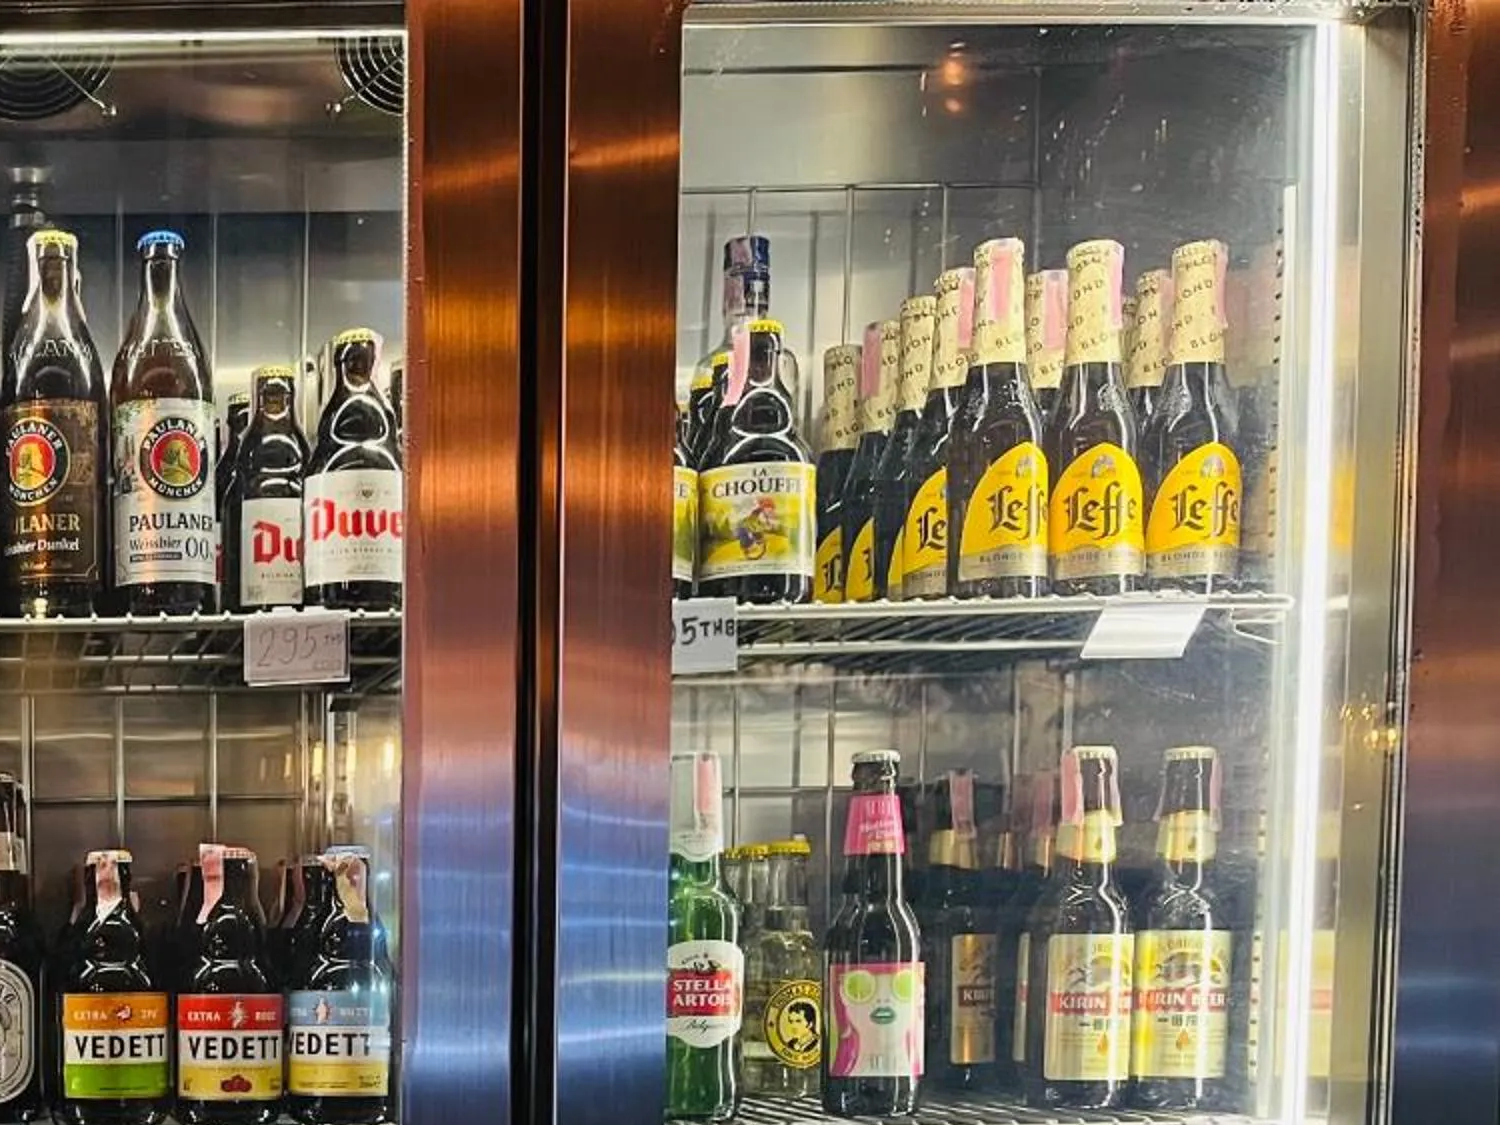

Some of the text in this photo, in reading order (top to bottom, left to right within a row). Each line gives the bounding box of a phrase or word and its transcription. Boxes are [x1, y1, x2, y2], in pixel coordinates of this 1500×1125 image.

[752, 467, 769, 478] LA
[672, 993, 731, 1007] ARTOI
[1058, 991, 1106, 1010] KIRIN
[186, 1011, 221, 1023] EXTRA
[74, 1034, 165, 1059] VEDETT
[187, 1036, 279, 1060] VEDETT
